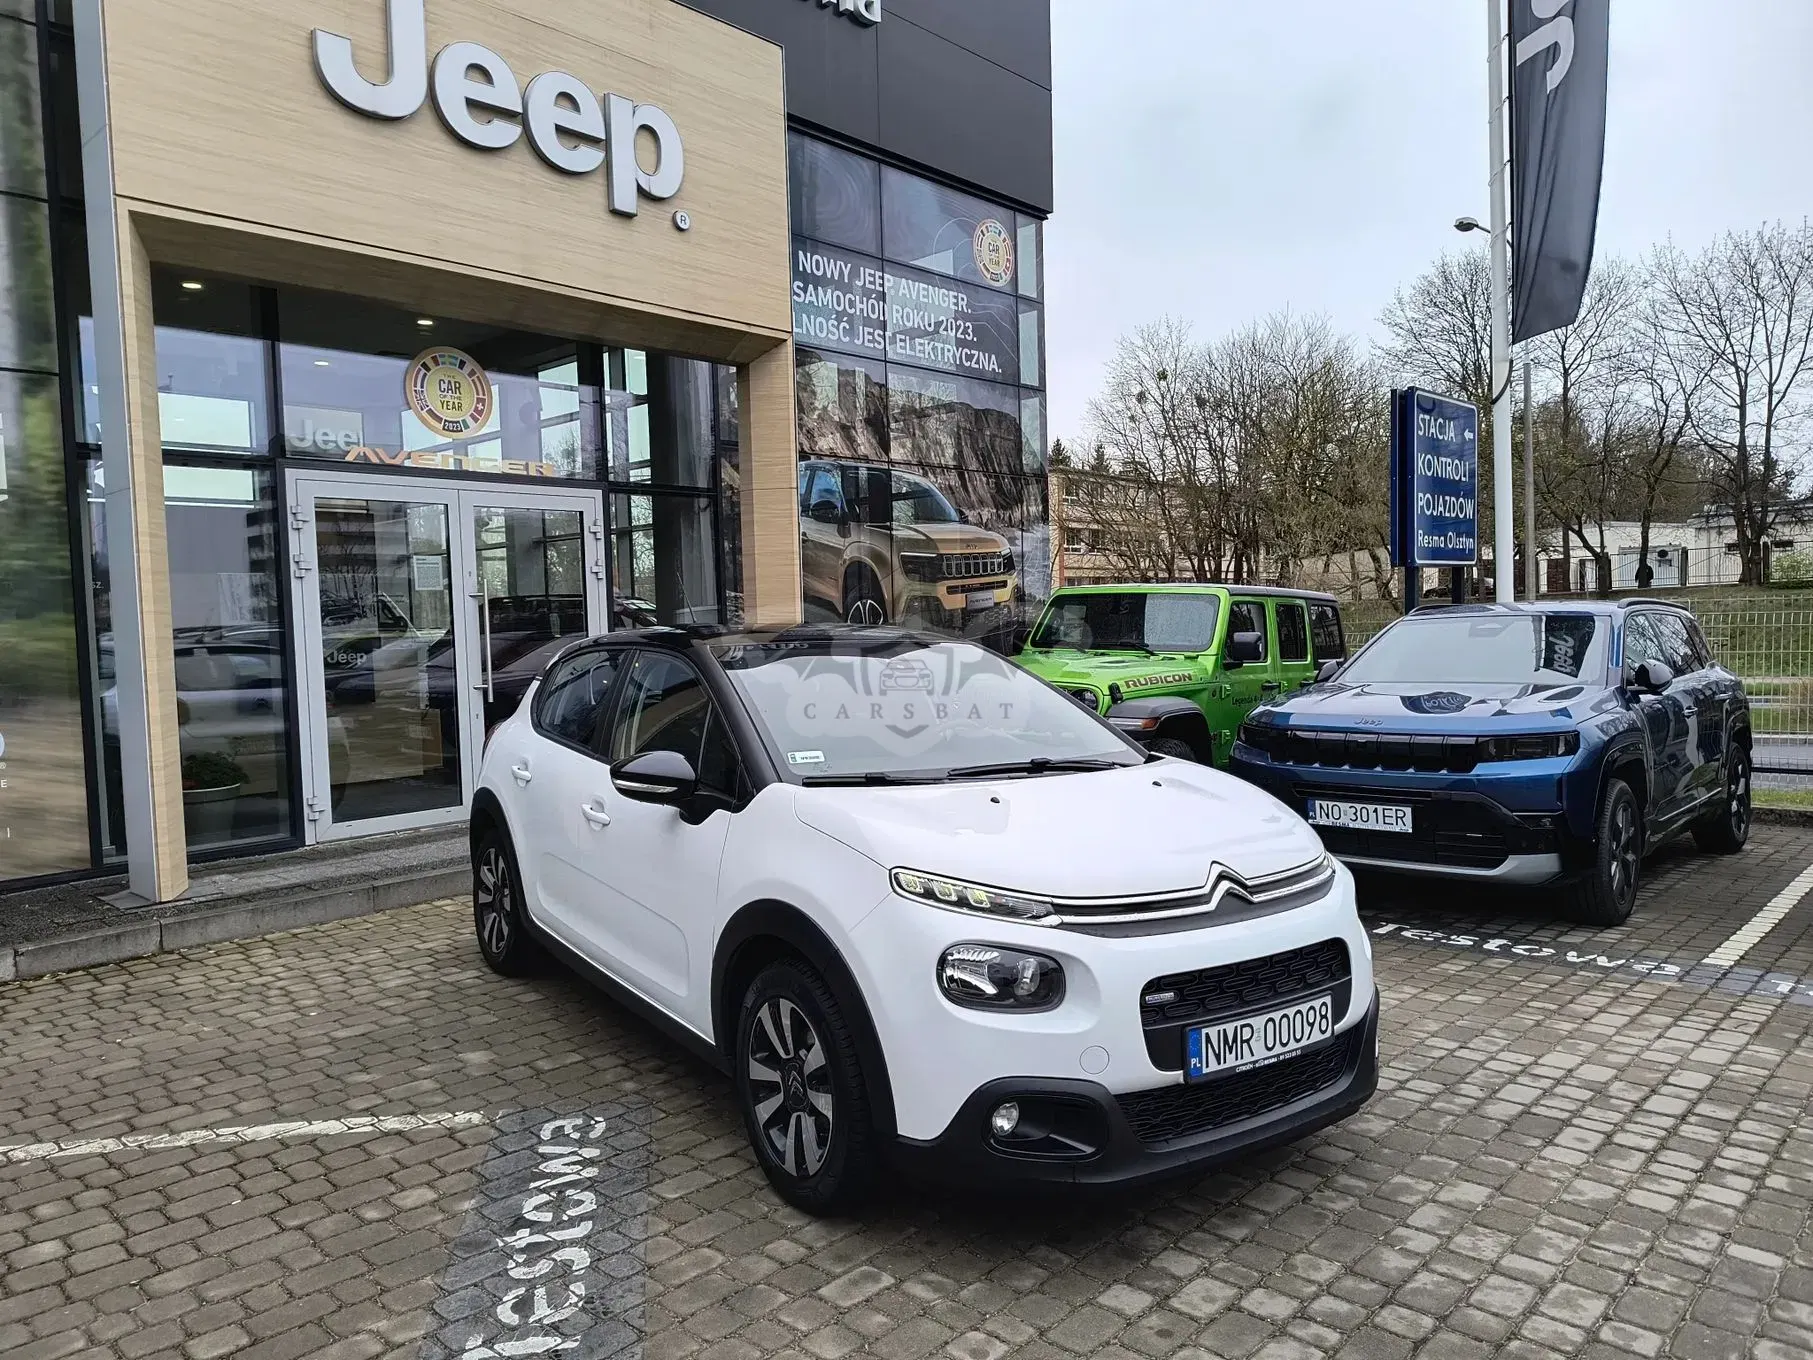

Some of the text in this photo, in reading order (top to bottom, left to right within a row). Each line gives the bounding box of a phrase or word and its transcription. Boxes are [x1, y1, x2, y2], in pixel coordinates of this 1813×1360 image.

[311, 0, 684, 218] Jeep
[988, 242, 1000, 254] CAR
[798, 250, 851, 283] NOWY
[899, 277, 972, 314] AVENGER.
[792, 280, 977, 342] SAMOCHÓD ROKU 2023.
[854, 325, 892, 351] JEST
[896, 334, 1002, 373] ELEKTRYCZNA.
[438, 379, 462, 395] CAR
[439, 400, 463, 412] YEAR
[444, 421, 461, 431] 2023
[1418, 415, 1456, 442] STACJA
[1418, 453, 1469, 482] KONTROLI
[1418, 491, 1474, 520] POJAZDÓW
[1418, 530, 1474, 554] Resma Olsztyn
[326, 650, 367, 665] Jeep
[1124, 673, 1194, 689] RUBICON
[1353, 717, 1384, 727] Jeep
[1319, 802, 1407, 826] NO 301ER
[1204, 1001, 1330, 1069] NMR 00098
[1191, 1056, 1201, 1069] PL
